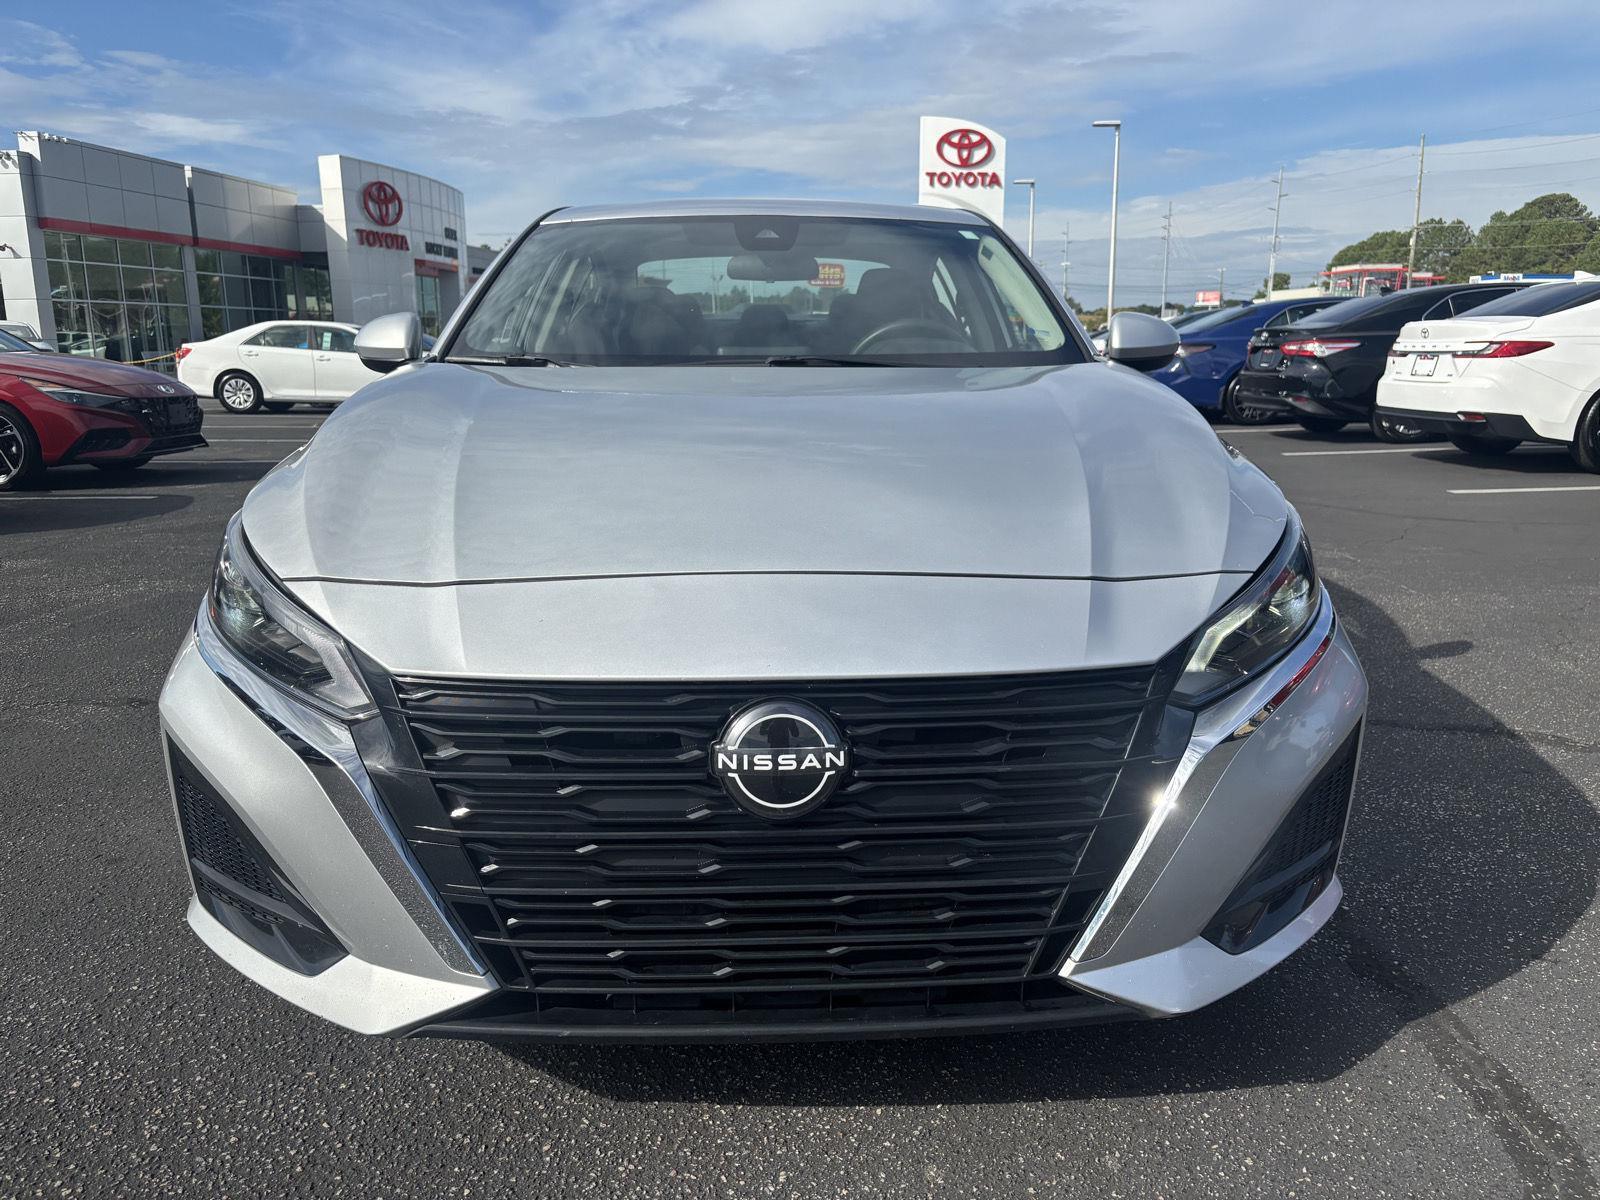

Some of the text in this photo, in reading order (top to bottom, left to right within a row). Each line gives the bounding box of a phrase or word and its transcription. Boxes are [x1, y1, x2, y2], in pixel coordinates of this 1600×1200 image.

[925, 171, 1002, 189] TOYOTA
[355, 229, 410, 252] TOYOTA
[717, 750, 845, 772] NISSAN
